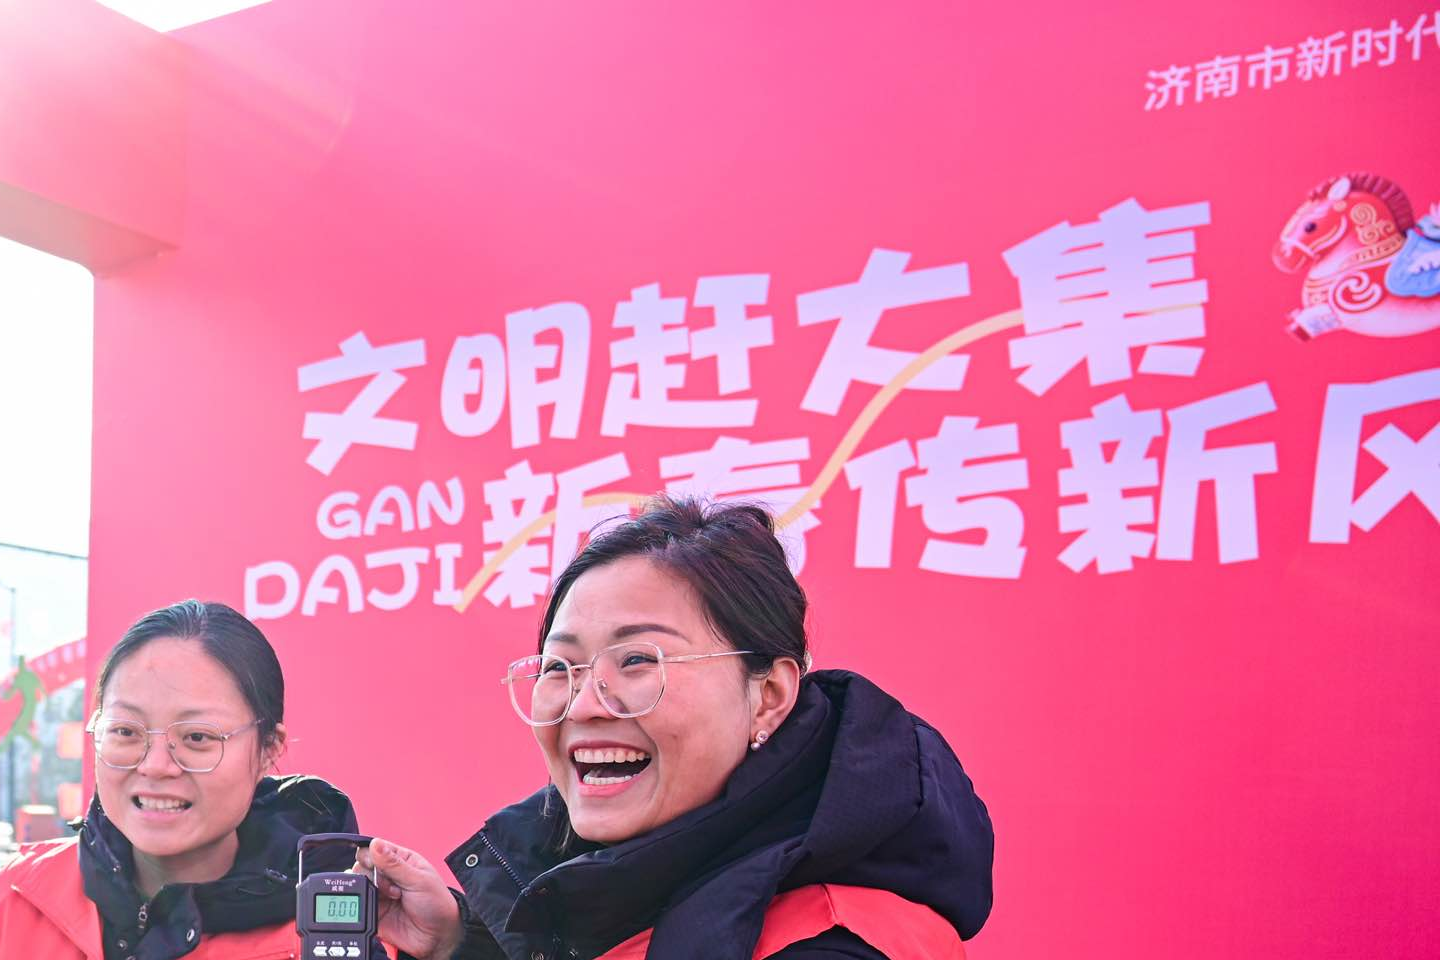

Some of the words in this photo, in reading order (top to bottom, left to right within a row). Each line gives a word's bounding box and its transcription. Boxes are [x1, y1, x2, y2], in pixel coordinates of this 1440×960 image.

[297, 197, 1211, 477] 文明赶大集
[316, 476, 465, 541] GAN
[244, 543, 463, 621] DAJI
